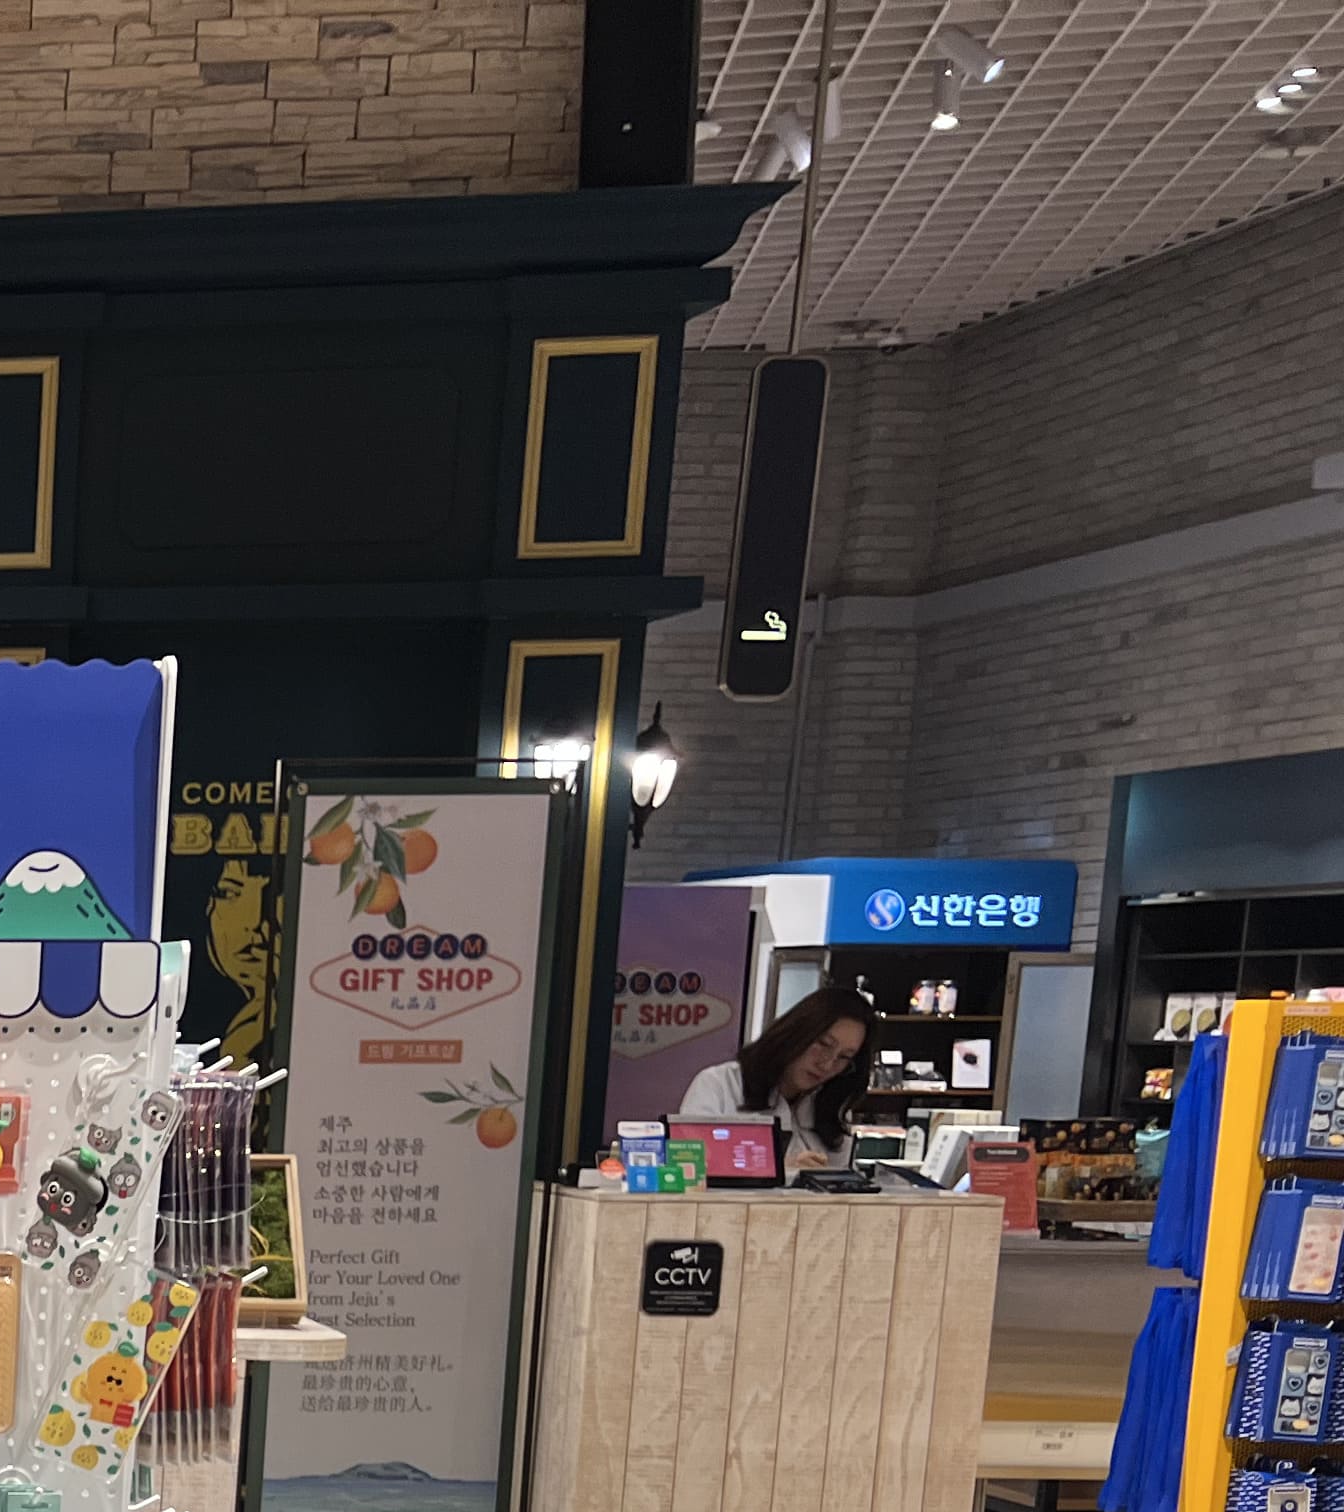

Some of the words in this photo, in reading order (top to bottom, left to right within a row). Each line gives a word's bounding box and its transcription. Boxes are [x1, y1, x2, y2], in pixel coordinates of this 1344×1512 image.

[182, 781, 273, 806] COME
[909, 893, 1042, 929] 신한은행
[355, 935, 487, 960] DREAM
[339, 968, 404, 993] GIFT
[417, 967, 494, 992] SHOP
[638, 1003, 709, 1026] SHOP
[319, 1114, 353, 1133] 제주
[317, 1137, 368, 1155] 최고의
[375, 1137, 425, 1156] 상품을
[316, 1159, 418, 1177] 엄선했습니다
[314, 1184, 365, 1203] 소중한
[371, 1184, 440, 1202] 사람에게
[312, 1206, 363, 1224] 마음을
[371, 1206, 438, 1225] 전하세요
[309, 1249, 366, 1265] Perfect
[371, 1249, 400, 1265] Gift
[336, 1270, 373, 1286] Your
[378, 1270, 425, 1286] Loved
[429, 1270, 461, 1286] One
[654, 1267, 712, 1286] CCTV
[345, 1312, 416, 1328] Selection
